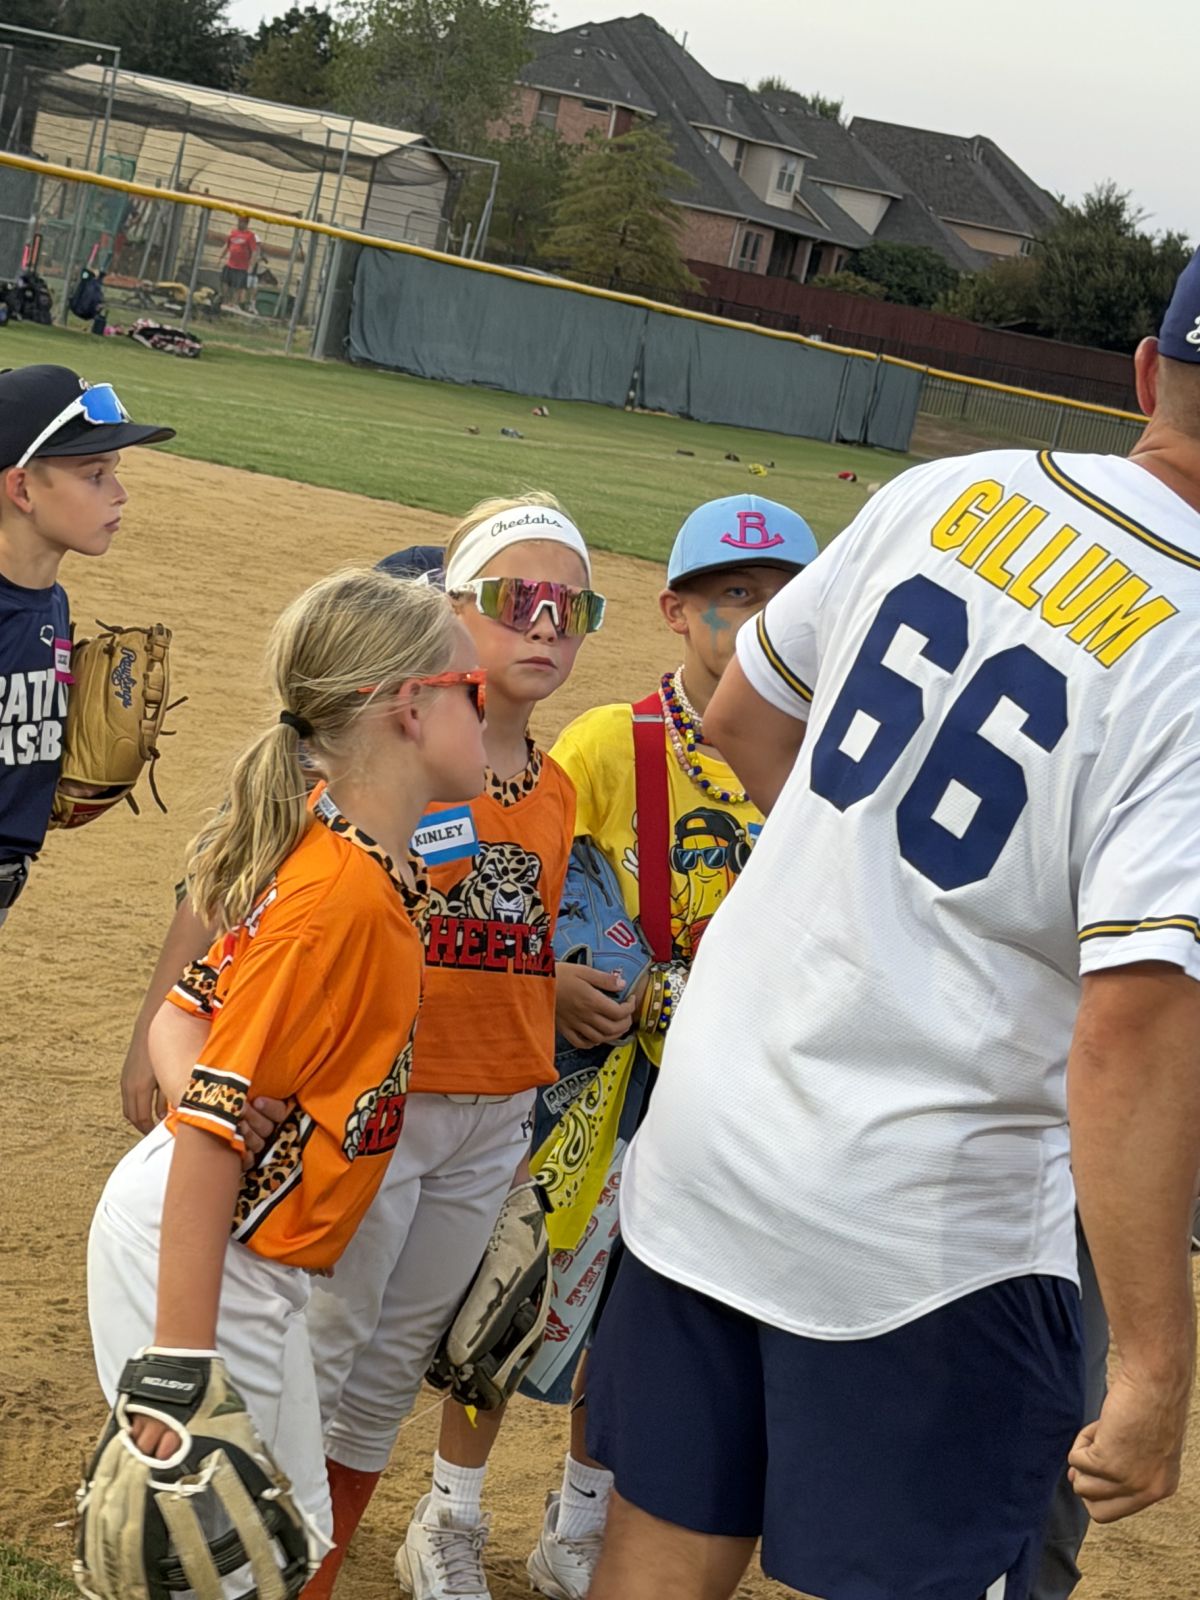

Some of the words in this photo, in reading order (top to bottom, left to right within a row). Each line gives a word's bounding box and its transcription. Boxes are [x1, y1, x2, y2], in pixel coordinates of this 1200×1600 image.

[491, 514, 563, 537] Cheetahs
[930, 479, 1179, 668] GILLUM
[810, 573, 1068, 891] 66
[414, 823, 463, 847] KINLEY
